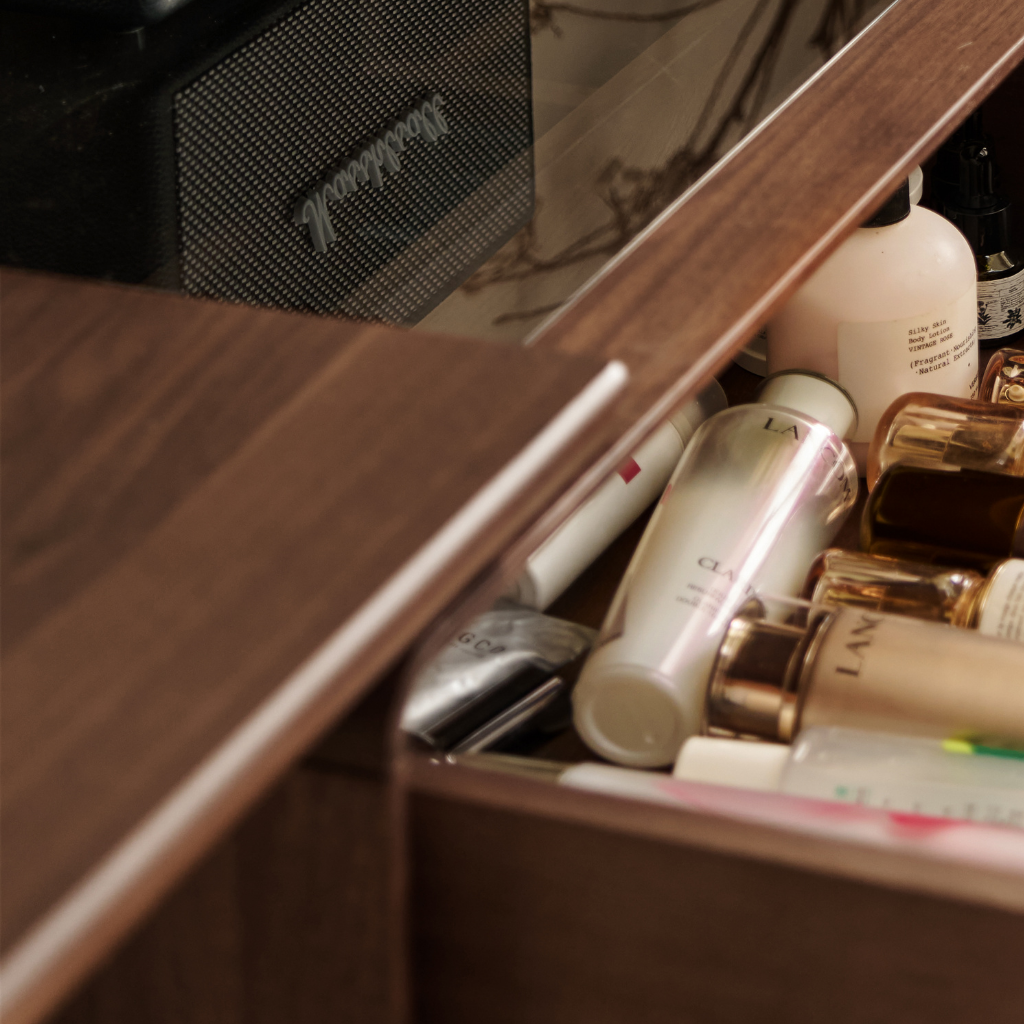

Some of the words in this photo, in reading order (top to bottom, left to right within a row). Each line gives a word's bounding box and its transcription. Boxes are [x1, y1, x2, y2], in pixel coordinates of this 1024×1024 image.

[908, 326, 929, 336] Silky
[932, 319, 947, 329] Skin
[908, 336, 926, 345] Body
[928, 326, 950, 339] Lotion
[908, 340, 937, 353] VINTAGE
[939, 332, 954, 344] ROSE
